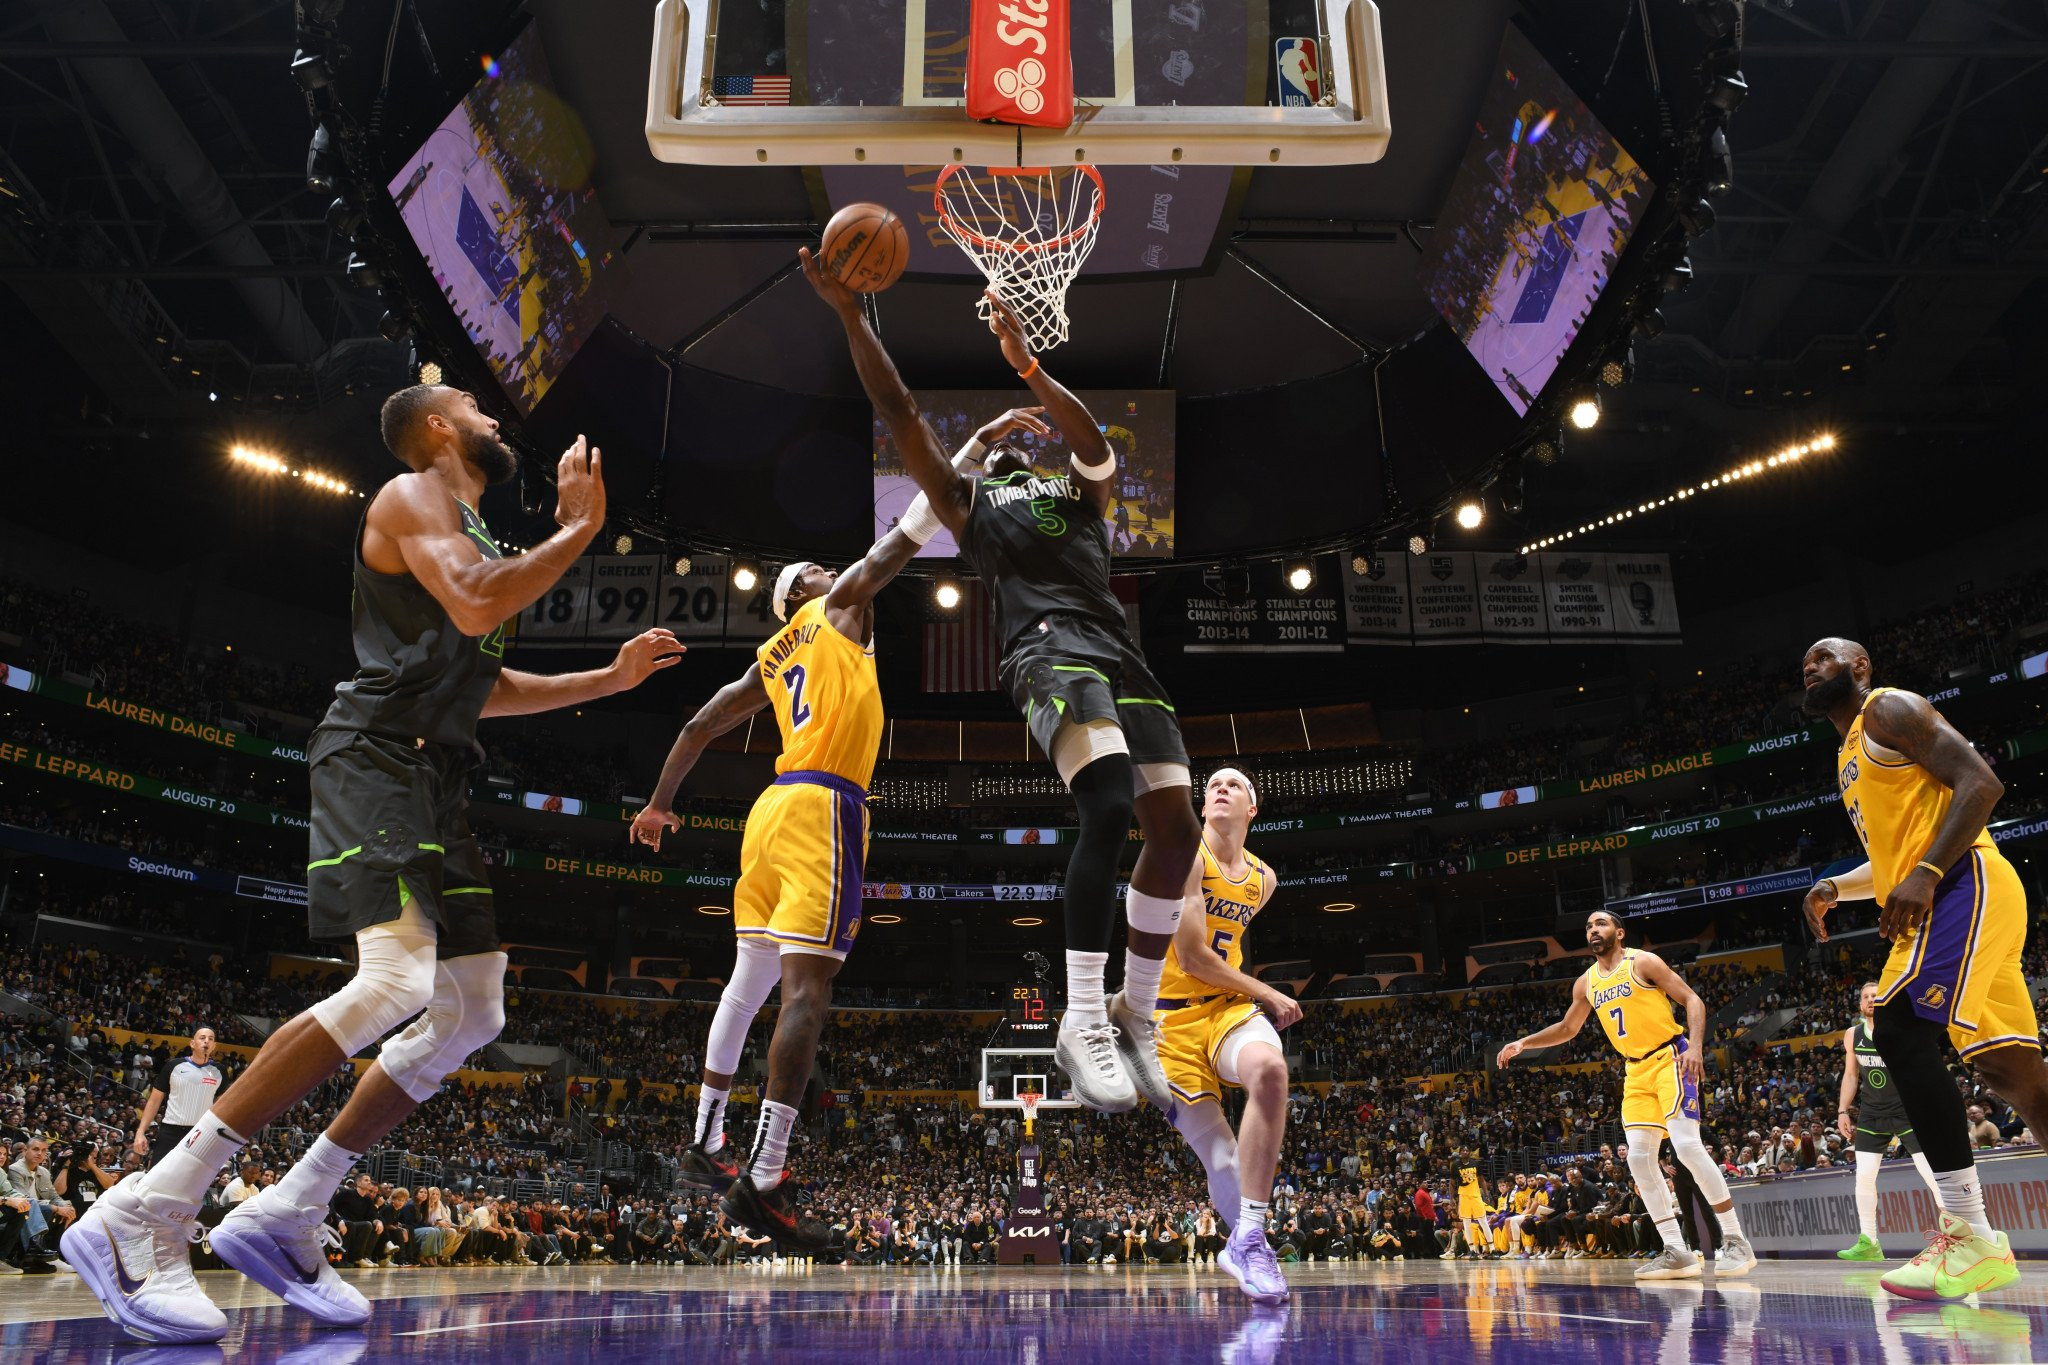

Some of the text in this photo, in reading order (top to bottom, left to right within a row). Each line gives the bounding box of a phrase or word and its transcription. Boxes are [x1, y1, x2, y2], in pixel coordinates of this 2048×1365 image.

[996, 0, 1049, 54] Sta
[1286, 95, 1306, 107] NBA
[1147, 193, 1173, 233] LAKERS
[1029, 498, 1067, 536] 5
[598, 565, 652, 577] GRETZKY
[1616, 564, 1662, 575] MILLER
[1354, 585, 1397, 594] WESTERN
[1422, 585, 1465, 594] WESTERN
[1487, 585, 1533, 594] CAMPBELL
[1560, 585, 1594, 593] SMYTHE
[533, 587, 573, 623] 18
[597, 586, 648, 623] 99
[664, 586, 718, 622] 20
[1187, 599, 1229, 608] STANLEY
[1266, 599, 1337, 609] STANLEY CUP
[1349, 594, 1404, 604] CONFERENCE
[1416, 594, 1474, 604] CONFERENCE
[1483, 594, 1540, 604] CONFERENCE
[1559, 595, 1598, 603] DIVISION
[1352, 605, 1403, 614] CHAMPIONS
[1419, 604, 1472, 615] CHAMPIONS
[1487, 604, 1538, 613] CHAMPIONS
[1554, 604, 1605, 613] CHAMPIONS
[1187, 610, 1258, 622] CHAMPIONS
[1266, 610, 1338, 622] CHAMPIONS
[1493, 616, 1535, 627] 1992-93
[1561, 616, 1601, 627] 1990-91
[1360, 617, 1397, 628] 2013-14
[1428, 617, 1466, 628] 2011-12
[1198, 626, 1250, 639] 2013-14
[1278, 626, 1329, 640] 2011-12
[1989, 672, 2008, 683] axs
[782, 663, 812, 733] 2
[1927, 687, 1960, 704] EATER
[86, 692, 236, 748] LAUREN DAIGLE
[1747, 731, 1811, 755] AUGUST 2
[272, 746, 309, 763] AUGU
[0, 742, 135, 791] EF LEPPARD
[1580, 752, 1713, 793] LAUREN DAIGLE
[161, 788, 236, 814] AUGUST 20
[498, 792, 513, 800] axs
[1819, 792, 1844, 806] THEA
[1395, 807, 1433, 818] THEATER
[282, 816, 311, 829] YAAM
[691, 816, 746, 831] DAIGLE
[1251, 820, 1304, 833] AUGUST 2
[1651, 817, 1720, 841] AUGUST 20
[1992, 820, 2048, 845] pectrum
[921, 833, 958, 841] THEATER
[1506, 834, 1629, 865] DEF LEPPARD
[128, 857, 194, 880] Spectrum
[544, 856, 663, 884] DEF LEPPARD
[686, 875, 733, 886] AUGUST
[1309, 874, 1348, 884] THEATER
[264, 885, 308, 898] Happy Birth
[866, 889, 872, 897] 5
[919, 886, 935, 898] 80
[956, 889, 984, 897] Lakers
[1001, 886, 1035, 900] 22.9
[1046, 890, 1052, 900] 3
[1709, 886, 1732, 900] 9:08
[1628, 896, 1676, 911] Happy Birthday
[1171, 911, 1180, 921] 5
[1211, 930, 1233, 962] 5
[1013, 988, 1039, 999] 22.7
[1593, 981, 1633, 1010] LAKERS
[1025, 999, 1044, 1020] 12
[1609, 1006, 1627, 1039] 7
[1868, 1068, 1887, 1089] 0
[1024, 1159, 1034, 1168] GET
[1024, 1168, 1034, 1177] THE
[1018, 1207, 1041, 1216] Google
[1981, 1180, 2048, 1231] WIN PR
[1741, 1196, 1792, 1238] PLAYOFFS
[1008, 1226, 1050, 1238] KIA
